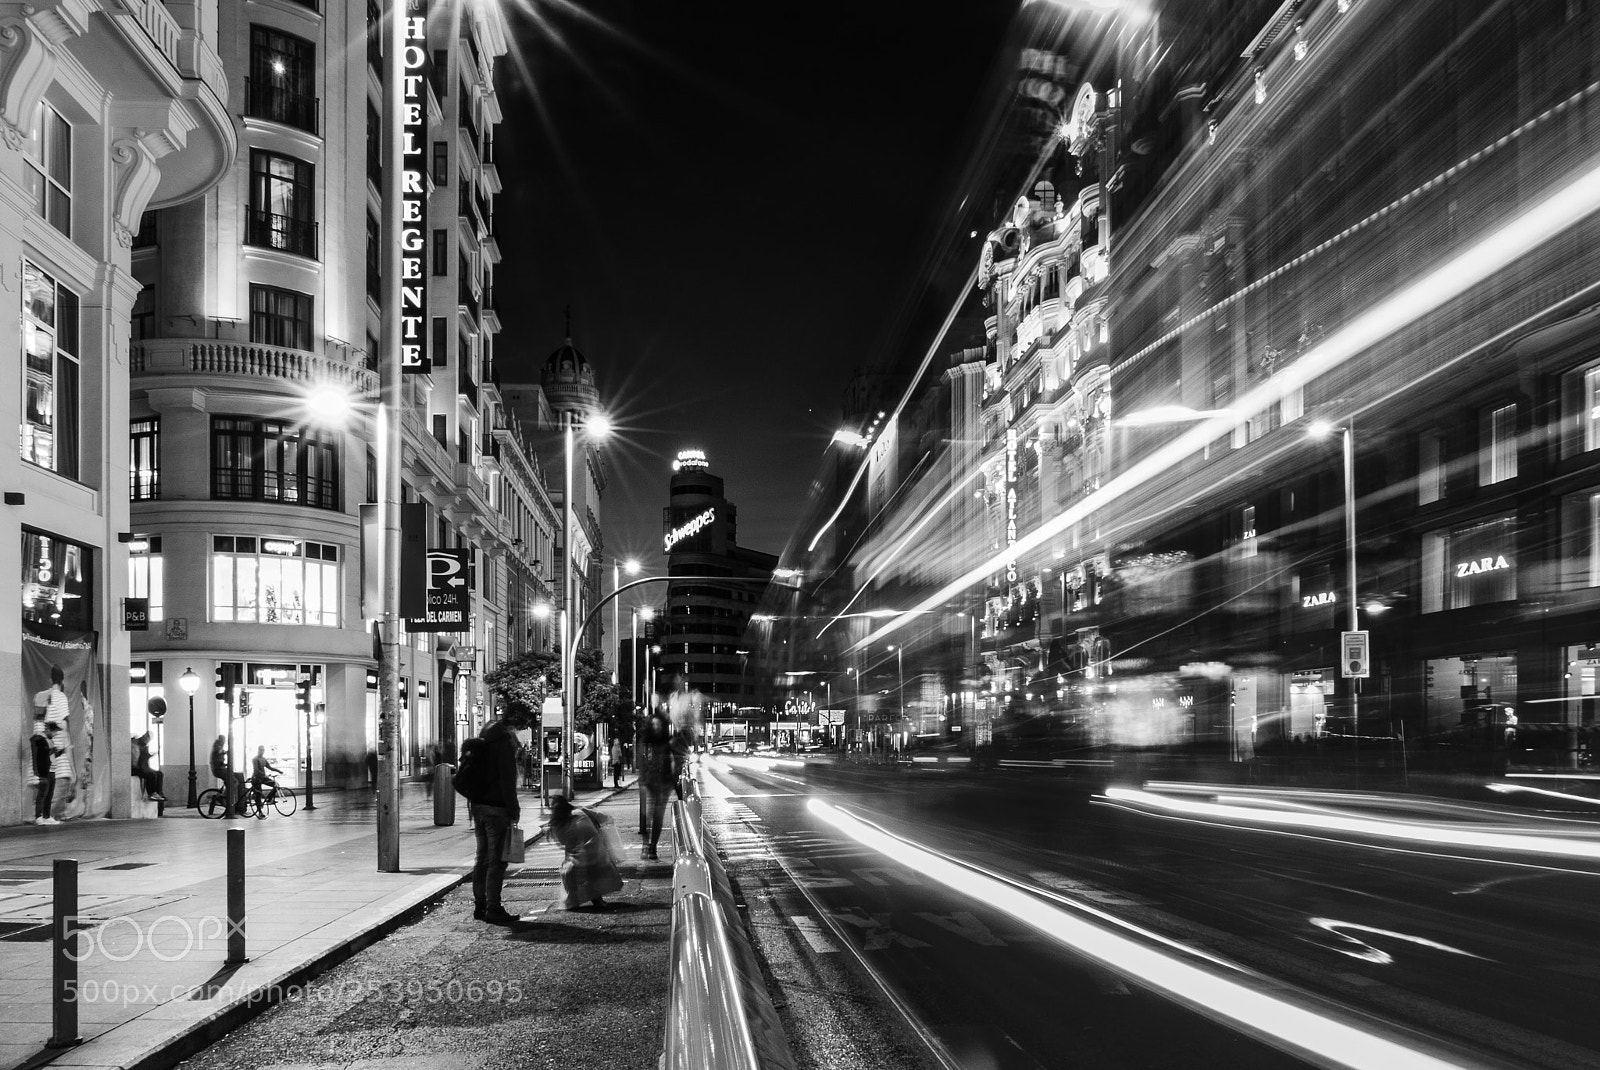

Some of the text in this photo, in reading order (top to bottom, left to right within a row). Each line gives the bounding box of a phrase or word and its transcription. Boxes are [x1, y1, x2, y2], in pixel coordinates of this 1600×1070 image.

[403, 17, 426, 155] HOTEL
[402, 171, 424, 367] REGENTE
[1006, 429, 1017, 581] HOTEL ATLANTCO
[664, 507, 715, 552] Schweppes
[1456, 555, 1510, 578] ZARA
[126, 611, 146, 621] P&B
[438, 610, 462, 622] CARMEN
[1303, 592, 1336, 608] ZARA
